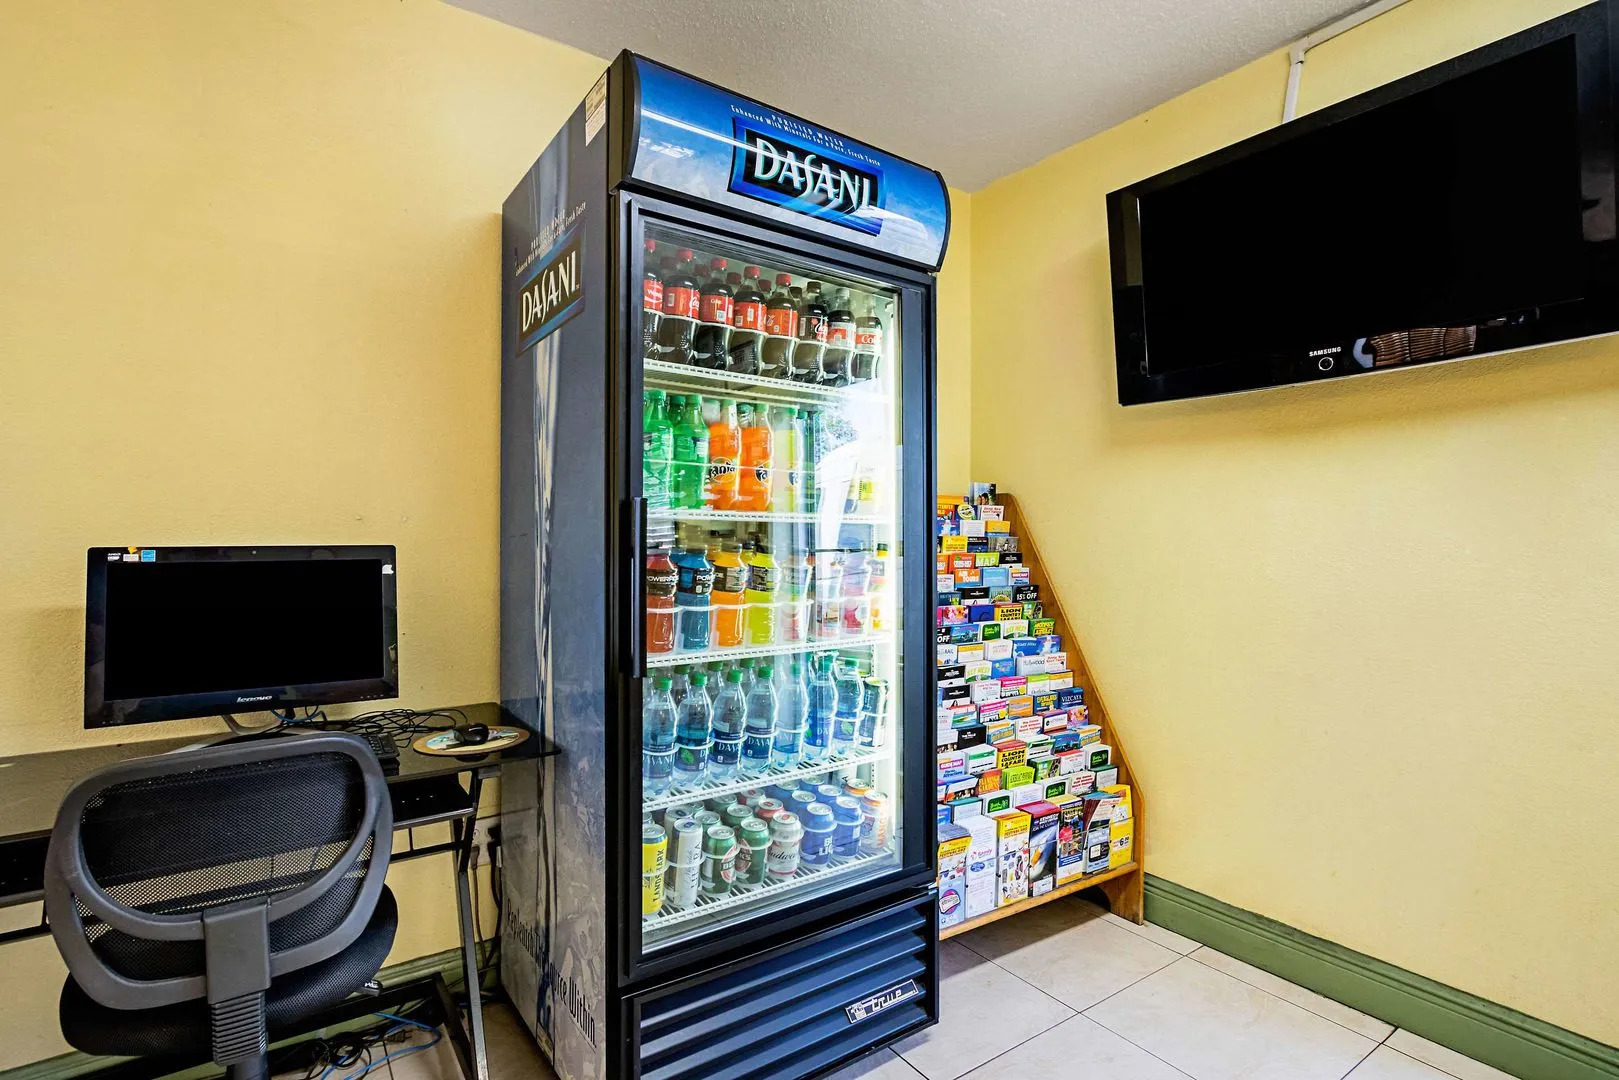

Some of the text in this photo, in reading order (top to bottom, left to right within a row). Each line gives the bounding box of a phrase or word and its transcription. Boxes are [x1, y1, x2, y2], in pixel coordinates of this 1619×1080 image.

[771, 114, 844, 147] PURIFIED WATER
[754, 138, 871, 210] DASANI
[522, 250, 576, 333] DASANI
[1308, 346, 1342, 358] SAMSUNG
[1002, 750, 1024, 758] LION
